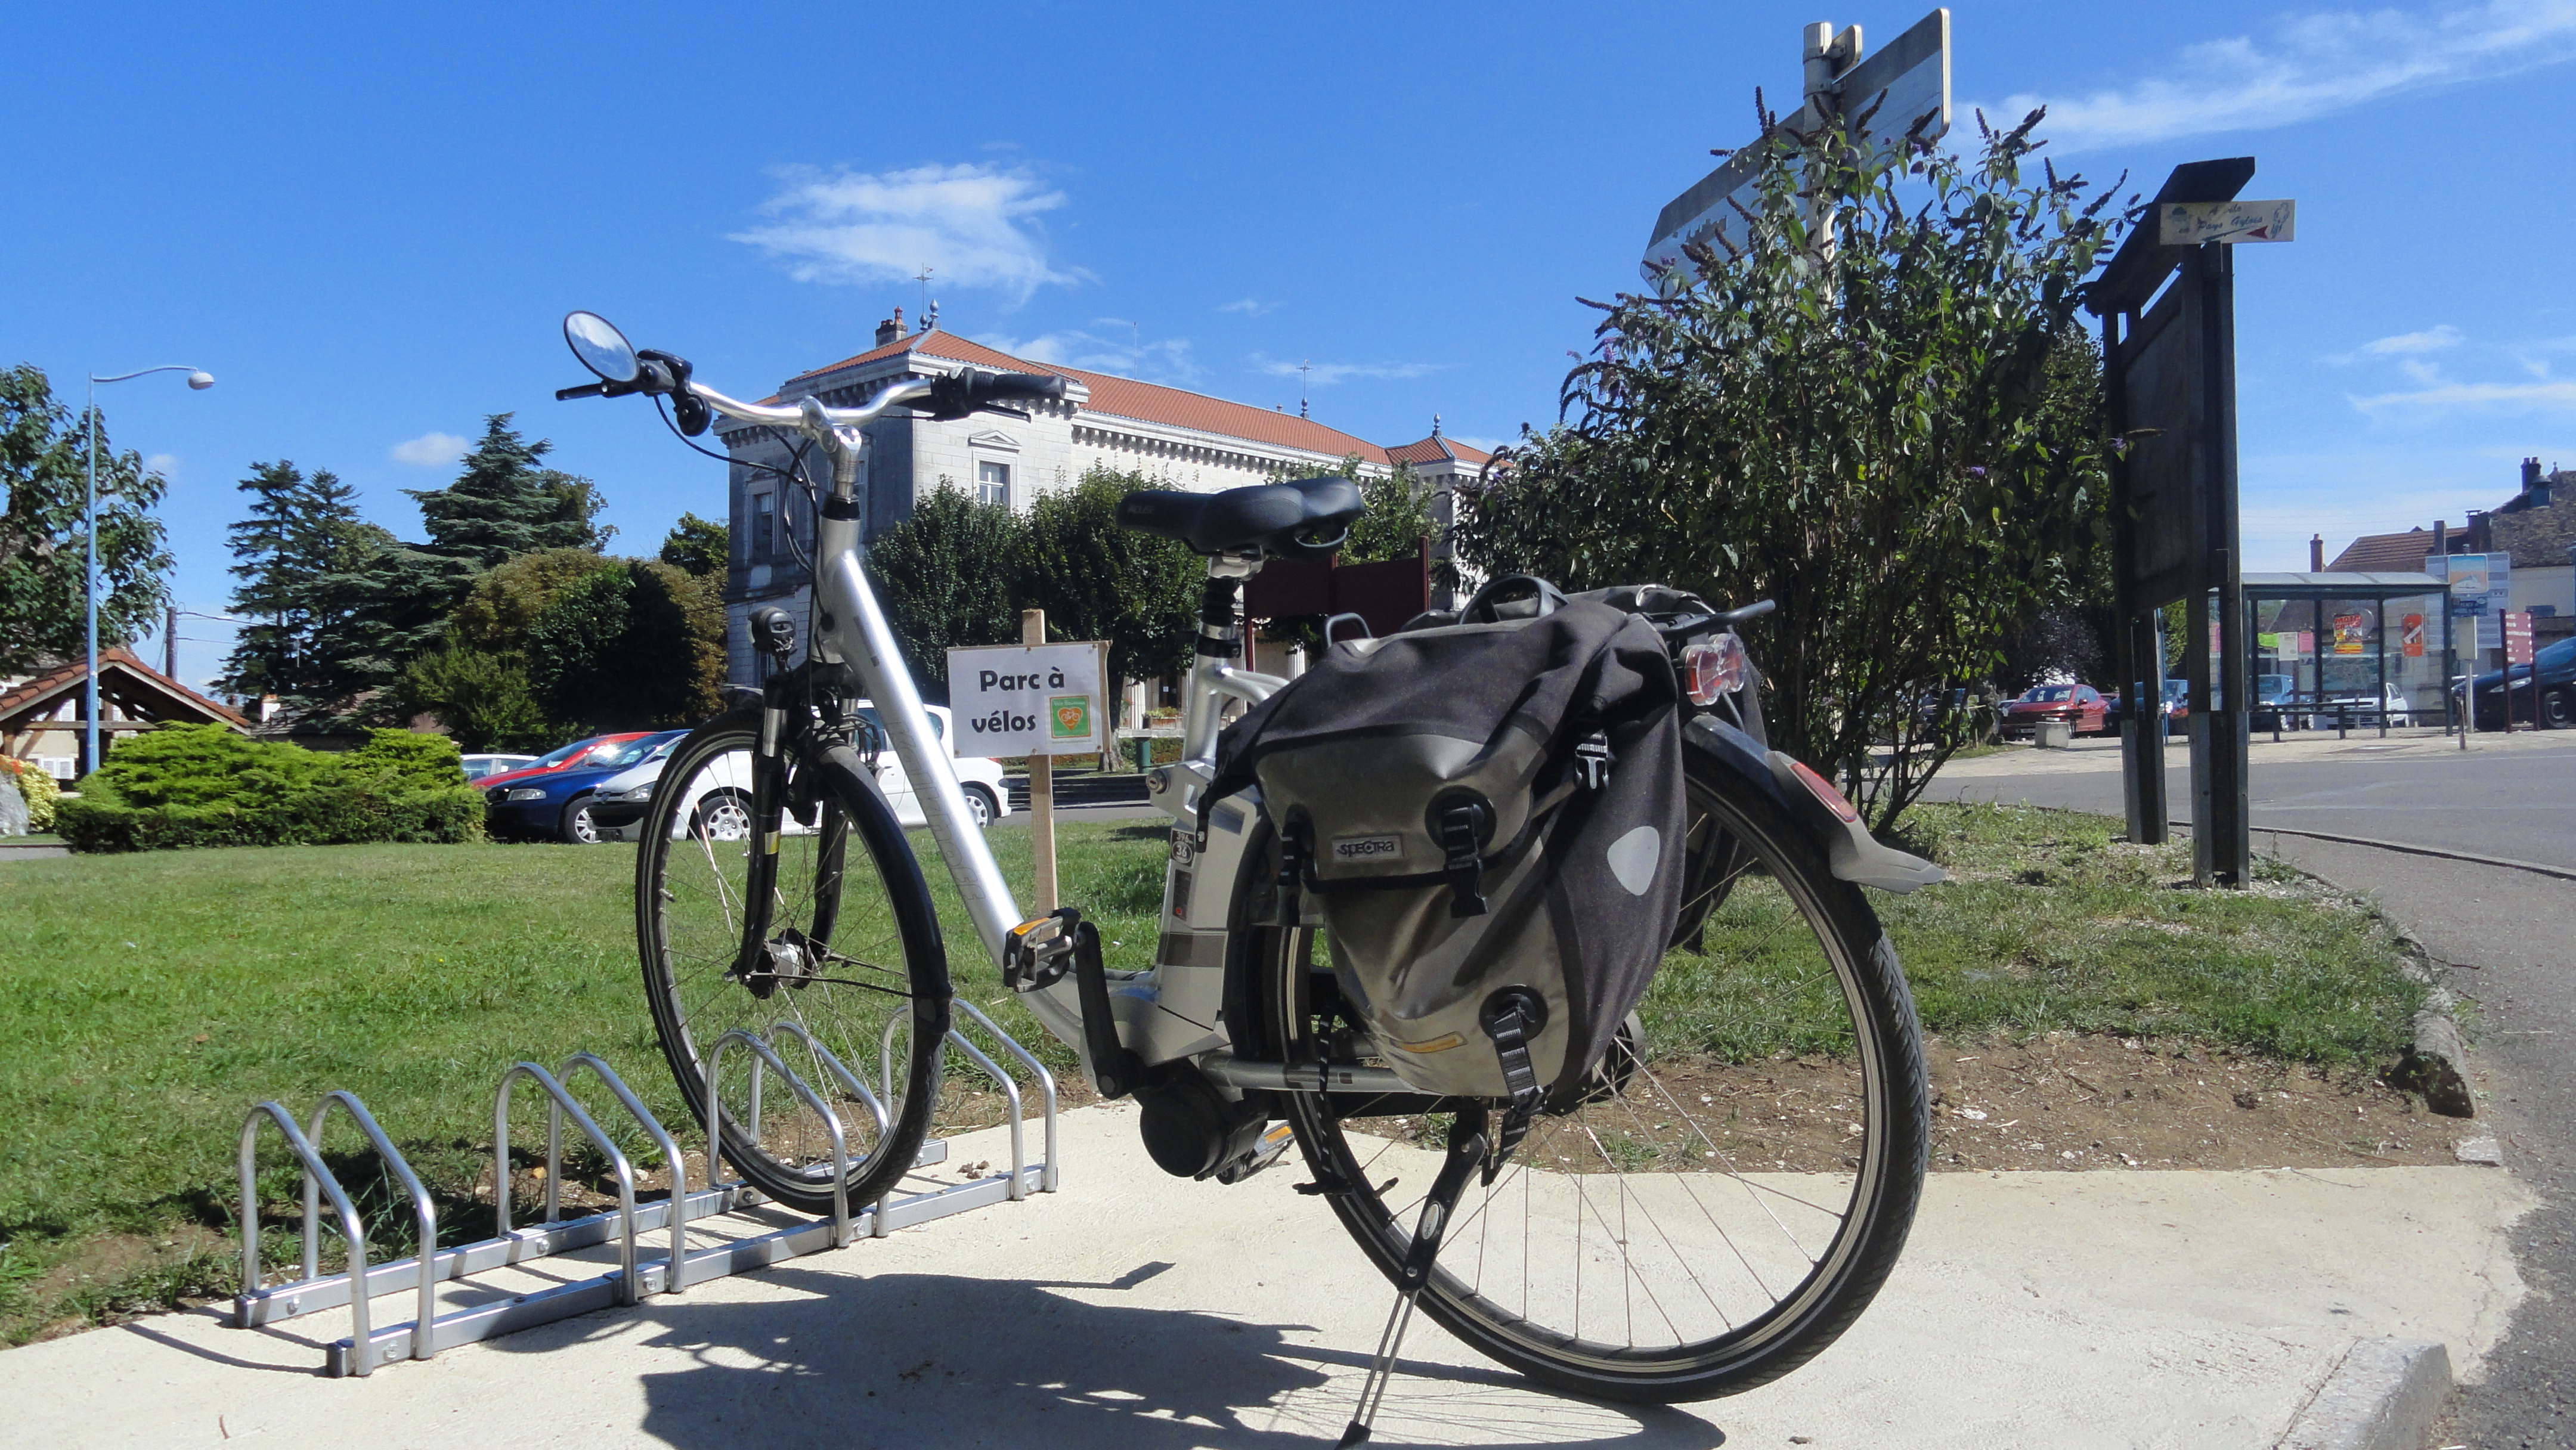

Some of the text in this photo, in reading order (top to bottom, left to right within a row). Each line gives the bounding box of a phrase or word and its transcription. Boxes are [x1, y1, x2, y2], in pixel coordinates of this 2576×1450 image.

[979, 666, 1065, 692] Parc à
[971, 709, 1036, 734] vélos
[1176, 845, 1187, 856] 36
